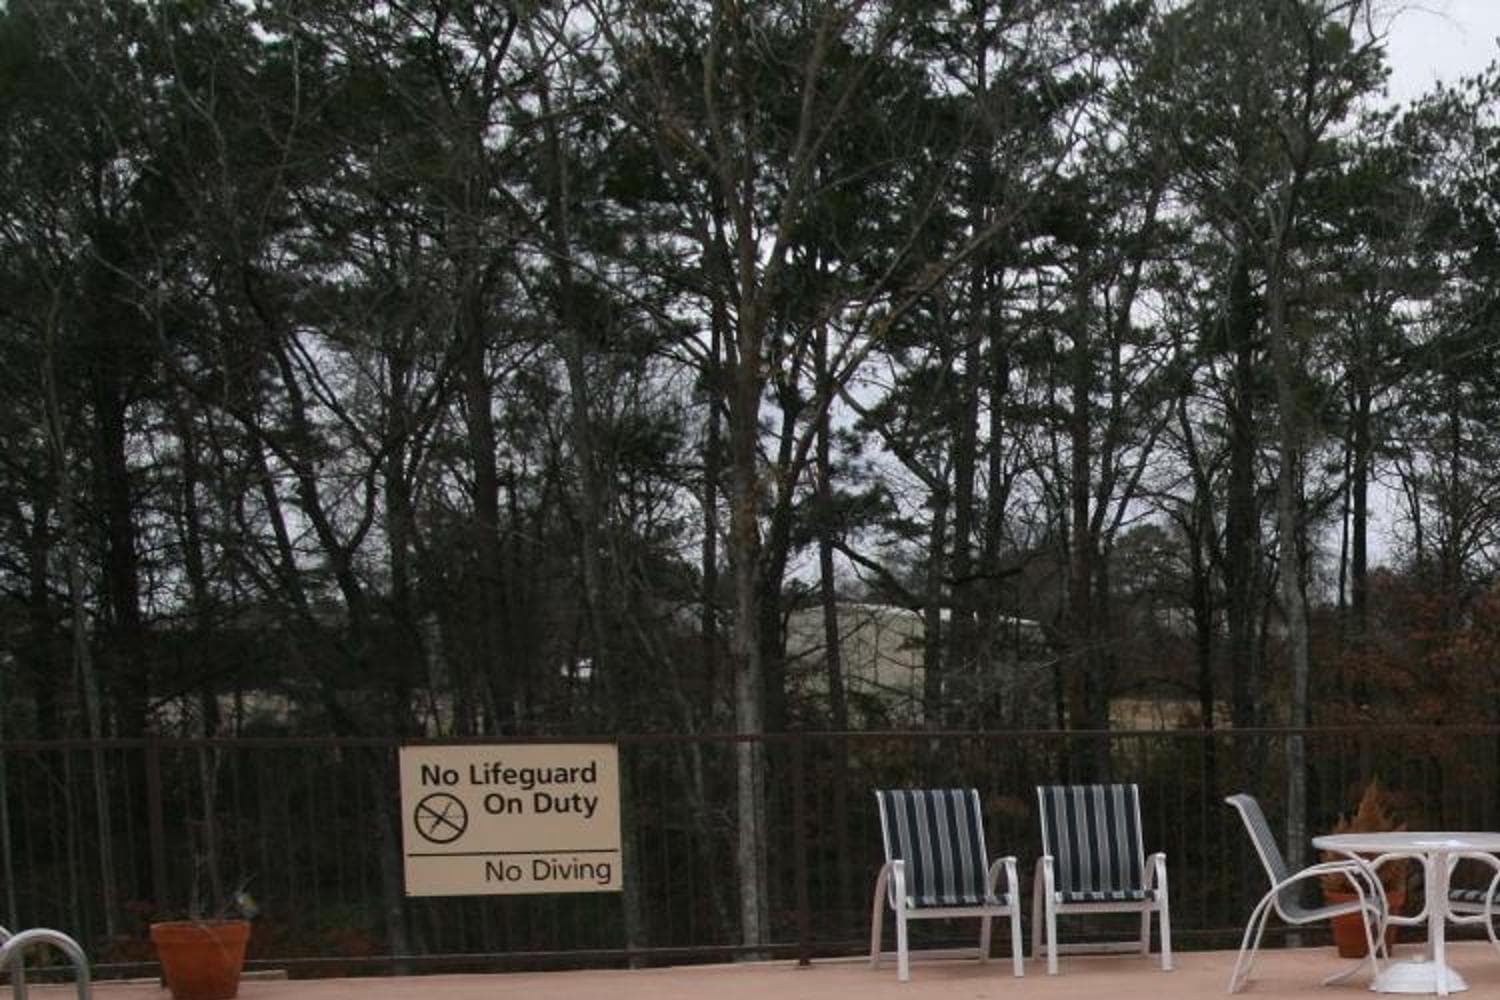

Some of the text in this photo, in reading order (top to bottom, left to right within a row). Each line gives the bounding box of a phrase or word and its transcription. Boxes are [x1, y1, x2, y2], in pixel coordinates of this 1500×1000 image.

[421, 760, 598, 790] No Lifeguard
[484, 791, 599, 819] On Duty
[485, 857, 612, 885] No Diving
